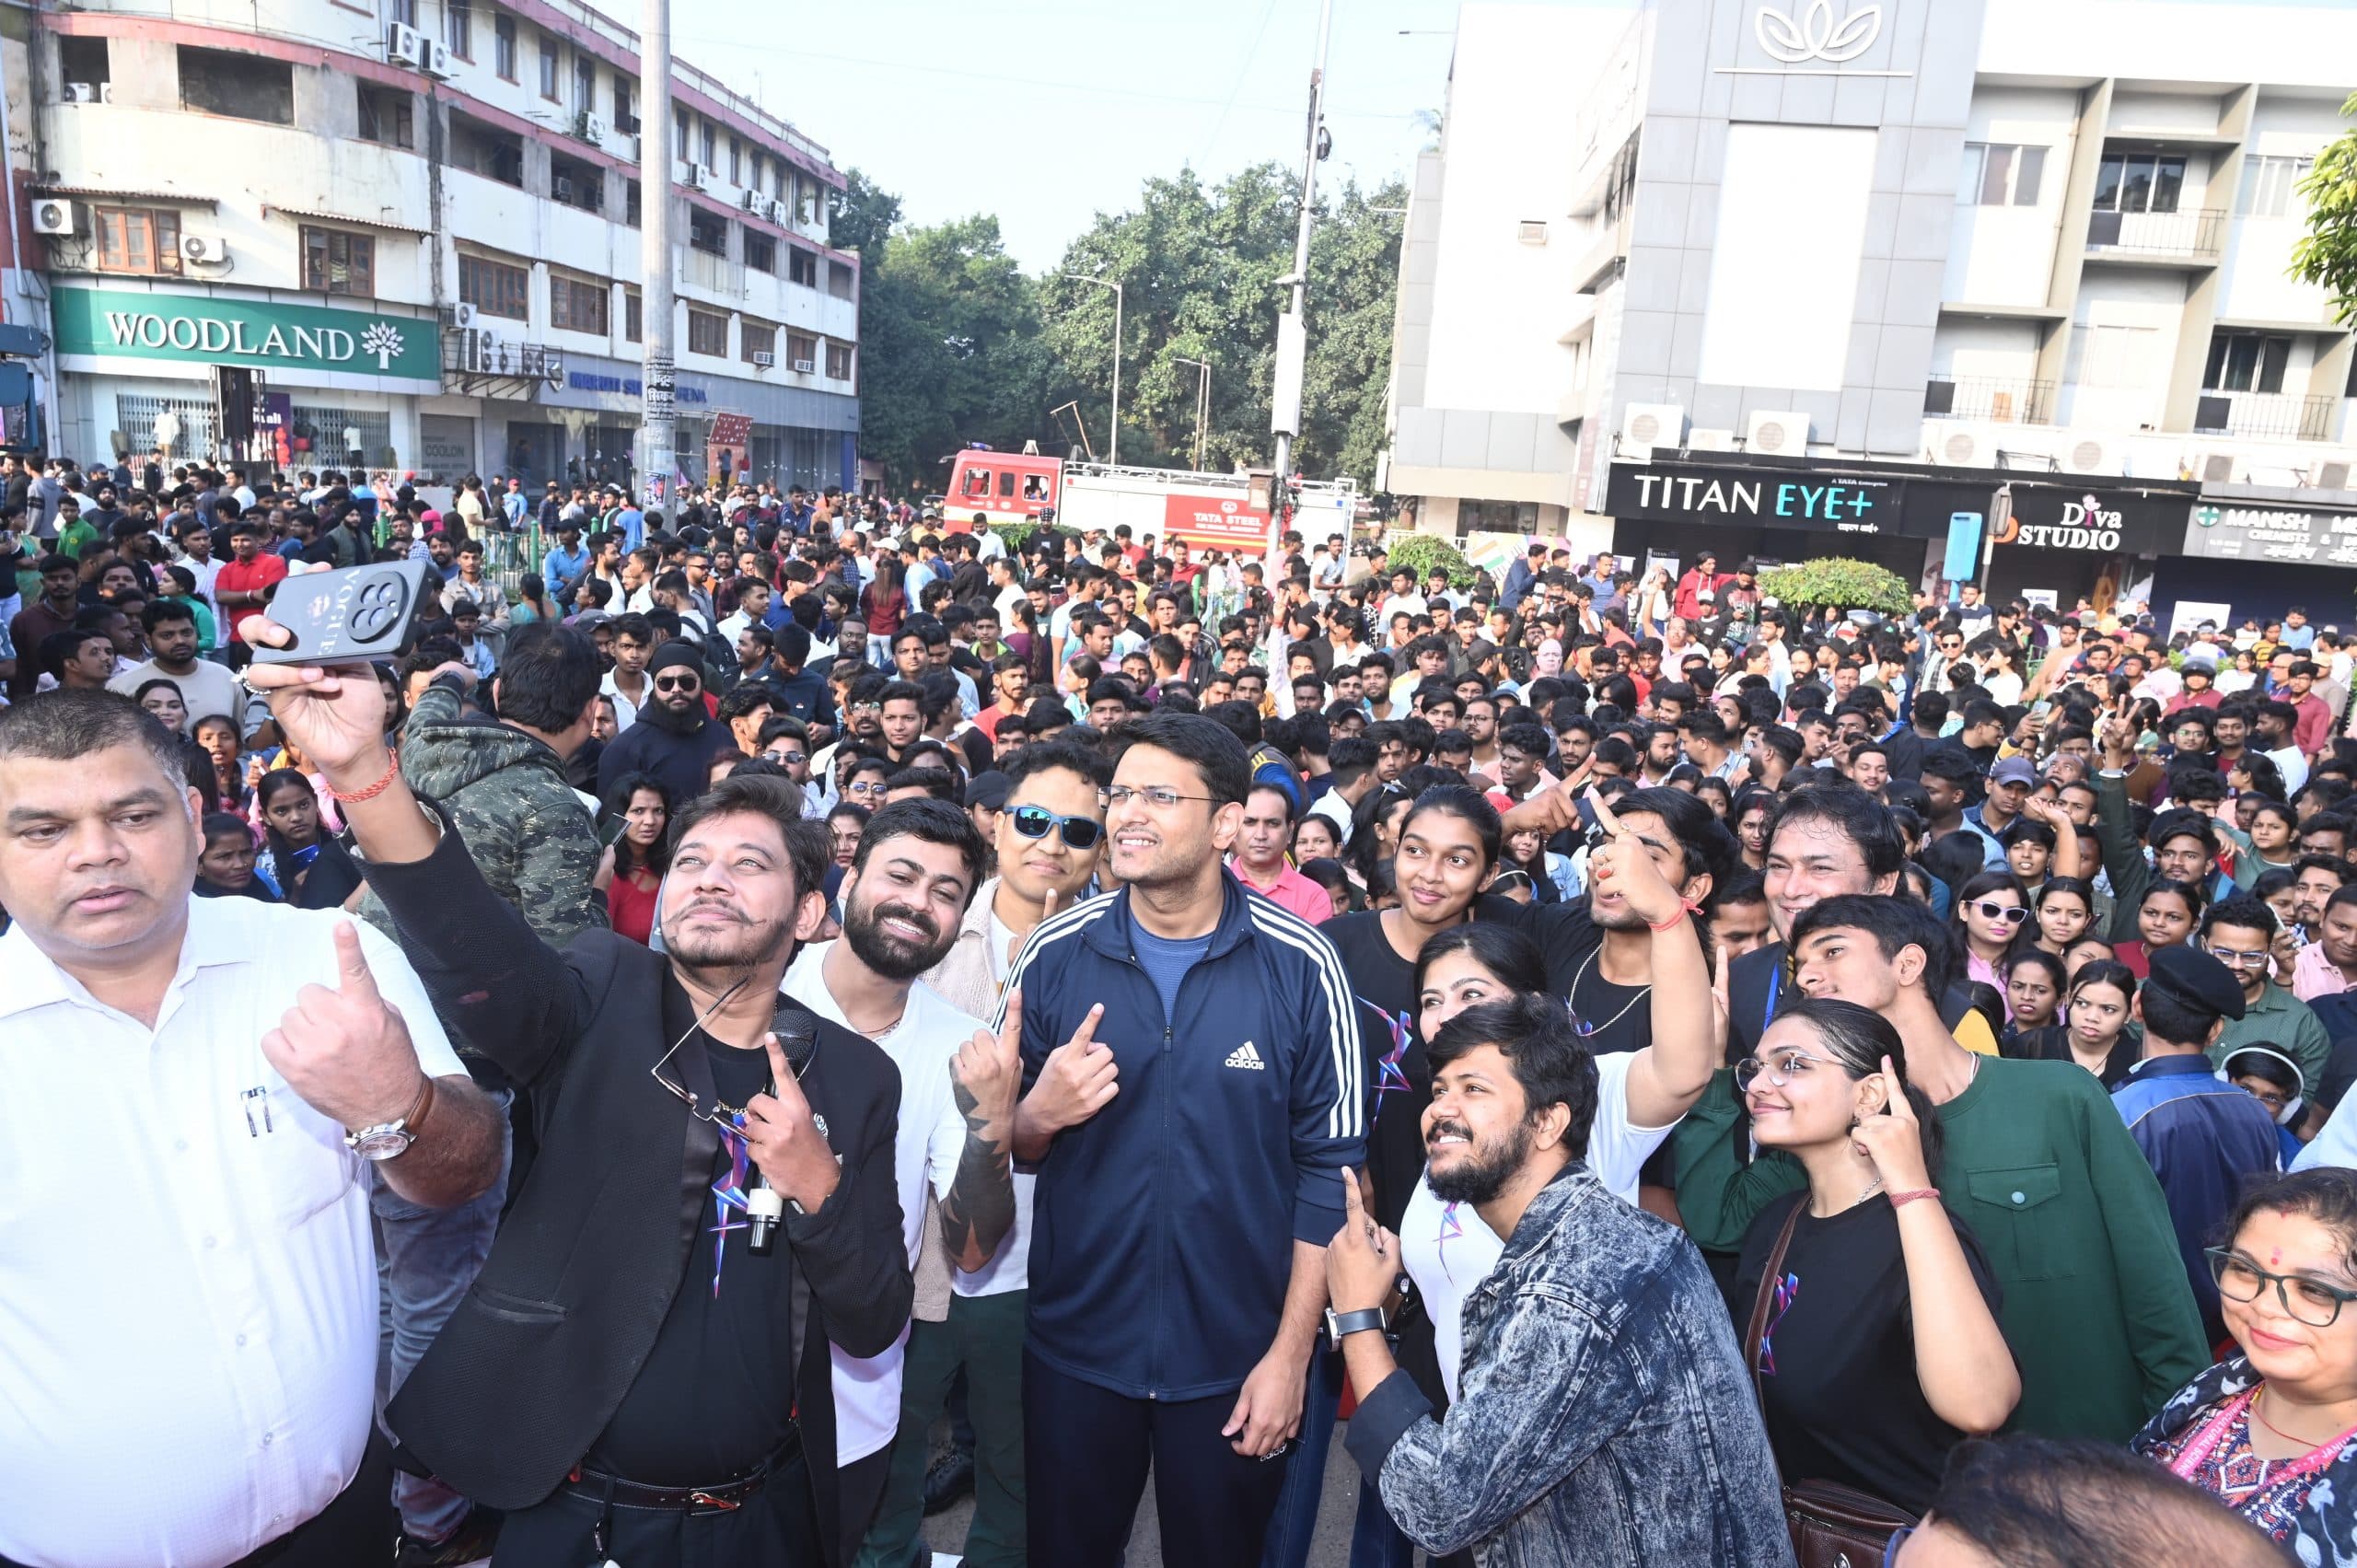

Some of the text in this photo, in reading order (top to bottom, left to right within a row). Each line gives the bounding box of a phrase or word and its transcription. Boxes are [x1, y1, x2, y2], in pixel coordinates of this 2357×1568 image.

[105, 311, 355, 361] WOODLAND
[1634, 475, 1873, 519] TITAN EYE+
[1193, 512, 1263, 527] TATA STEEL
[2061, 502, 2122, 529] Diva
[2224, 508, 2312, 532] MANISH
[2017, 524, 2120, 552] STUDIO
[2247, 528, 2312, 544] CHEMISTS
[318, 568, 361, 656] VOGUE
[1225, 1058, 1265, 1070] adidas
[2200, 1397, 2247, 1448] AGRICULTURAL
